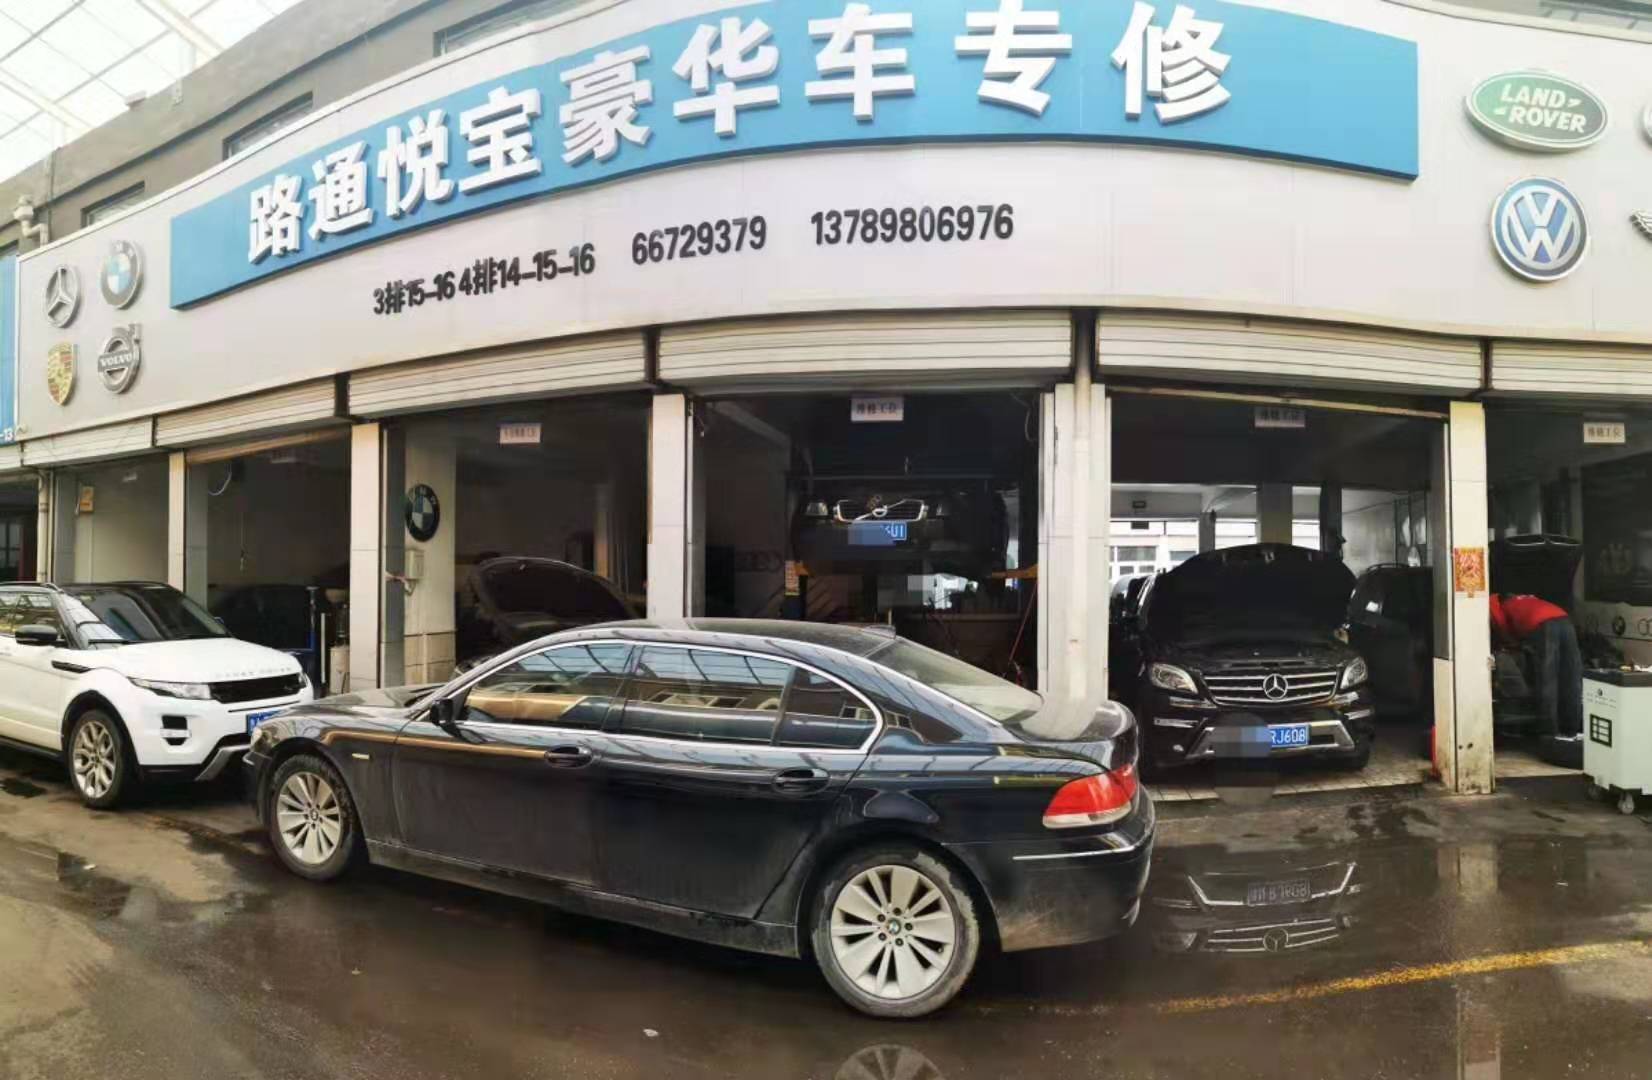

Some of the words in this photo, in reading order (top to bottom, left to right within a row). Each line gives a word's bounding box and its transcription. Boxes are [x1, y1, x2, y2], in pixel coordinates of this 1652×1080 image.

[1501, 84, 1566, 108] LAND
[248, 0, 1232, 264] 路通悦宝豪华车专修
[1509, 106, 1587, 133] ROVER
[631, 215, 767, 265] 66729379
[810, 204, 1014, 245] 13789806976
[100, 354, 133, 368] VOLVO
